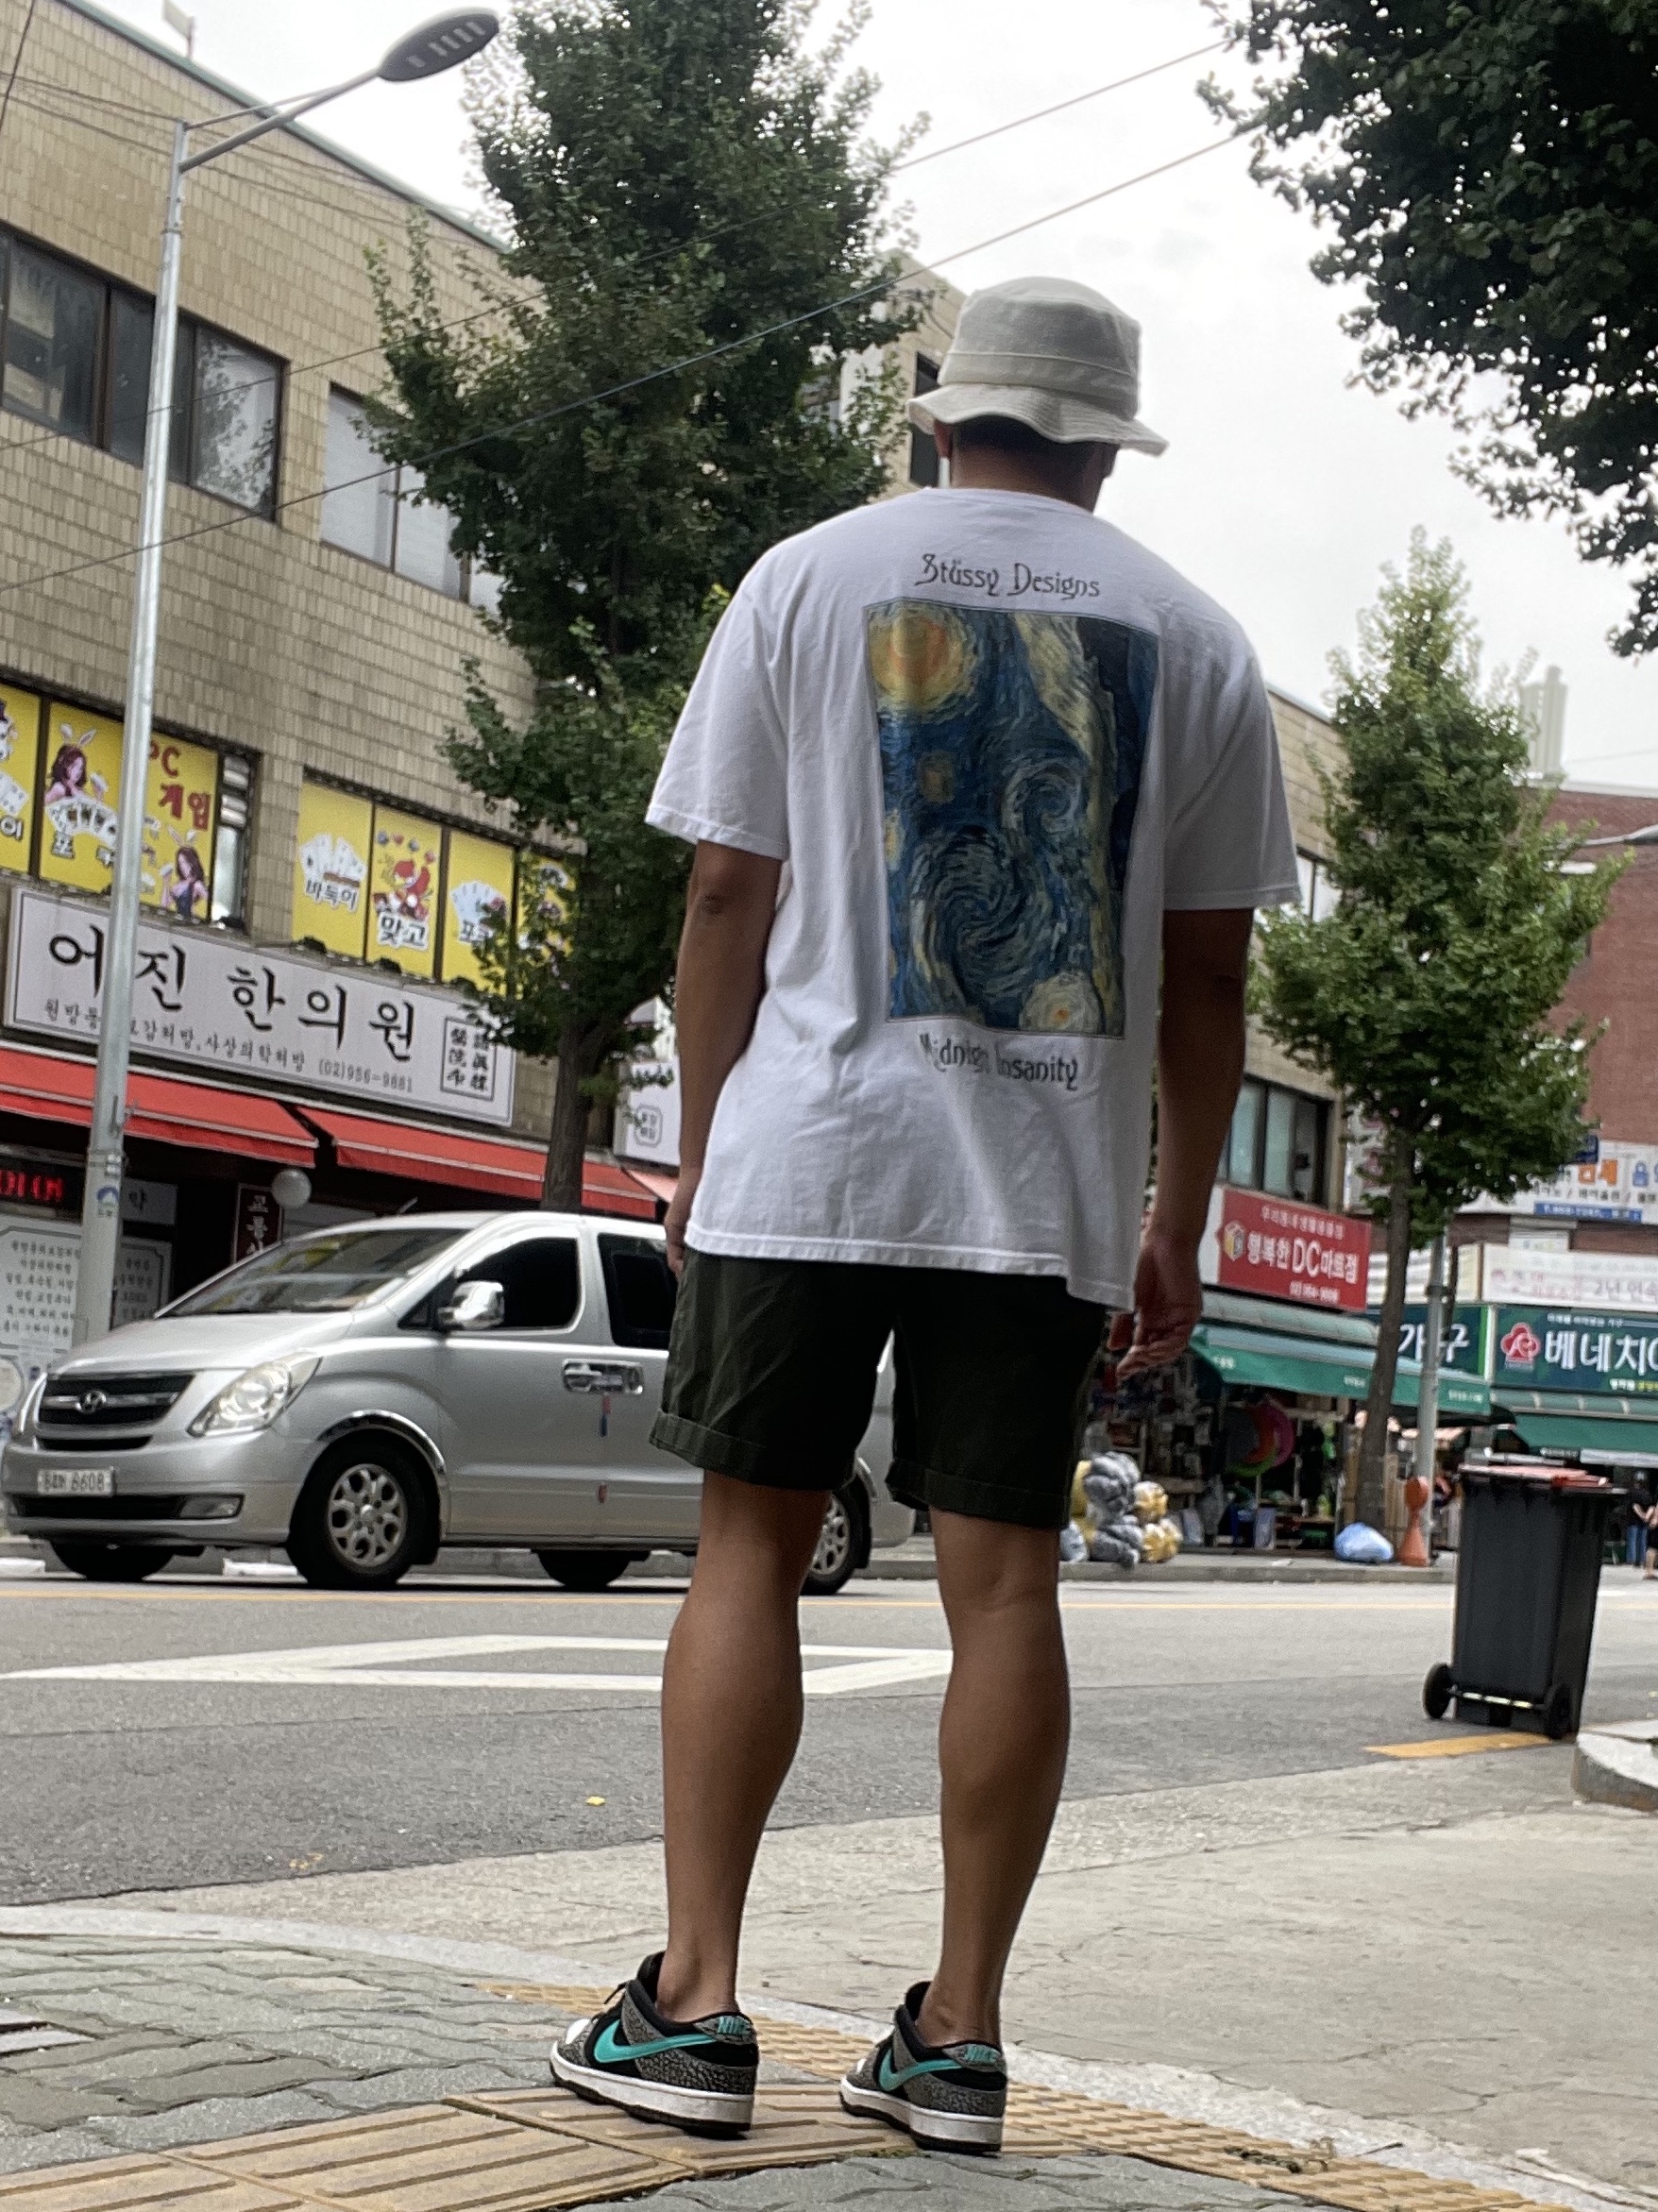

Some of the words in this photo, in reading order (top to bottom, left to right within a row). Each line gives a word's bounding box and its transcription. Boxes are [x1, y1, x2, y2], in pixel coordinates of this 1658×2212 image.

[914, 553, 1000, 597] Stüssy
[1007, 563, 1100, 600] Designs
[159, 783, 211, 831] 게임
[306, 879, 358, 909] 바둑이
[381, 914, 426, 945] 맞고
[48, 924, 186, 1011] 어진
[227, 965, 415, 1062] 한의원
